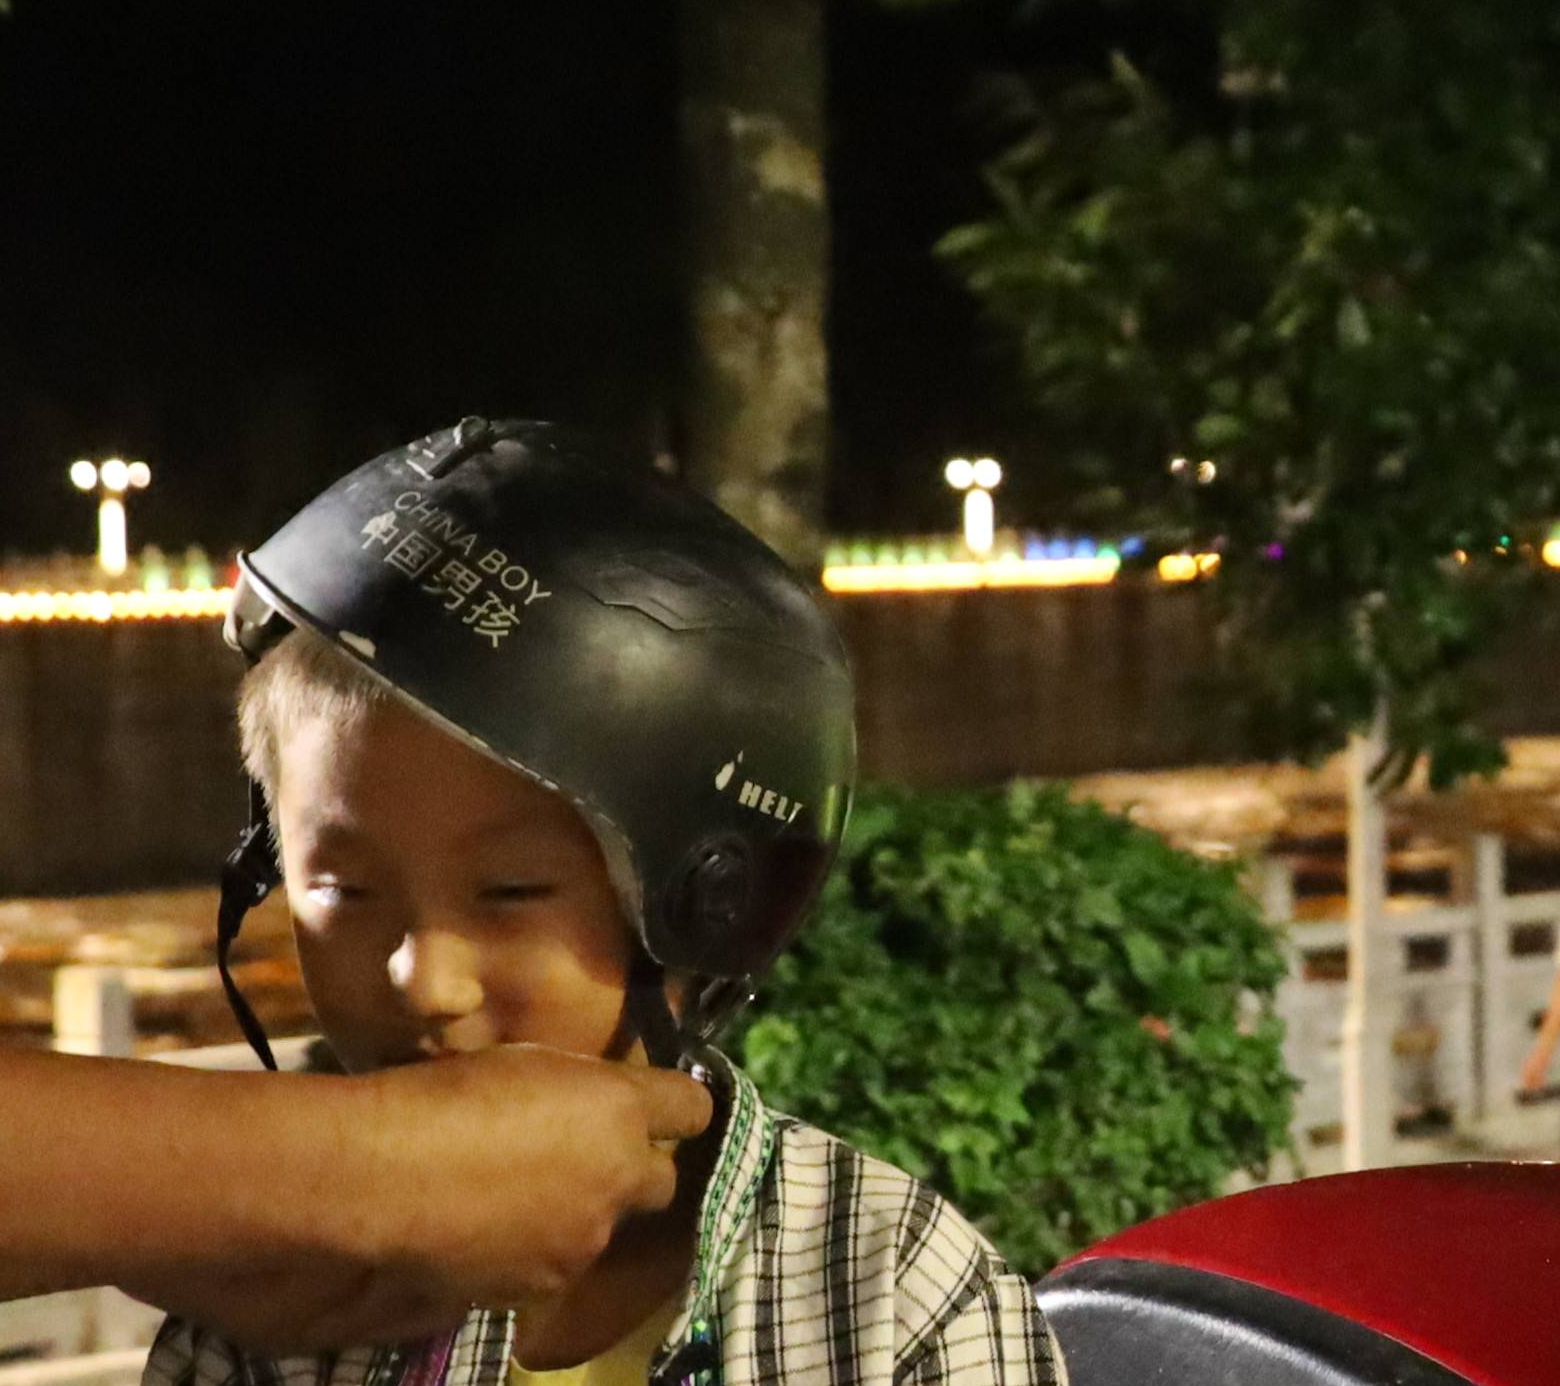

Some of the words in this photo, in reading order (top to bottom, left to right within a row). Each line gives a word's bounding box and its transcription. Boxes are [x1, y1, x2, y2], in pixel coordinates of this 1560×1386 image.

[360, 510, 520, 648] 中国男孩
[395, 490, 477, 556] CHINA
[478, 548, 552, 606] BOY
